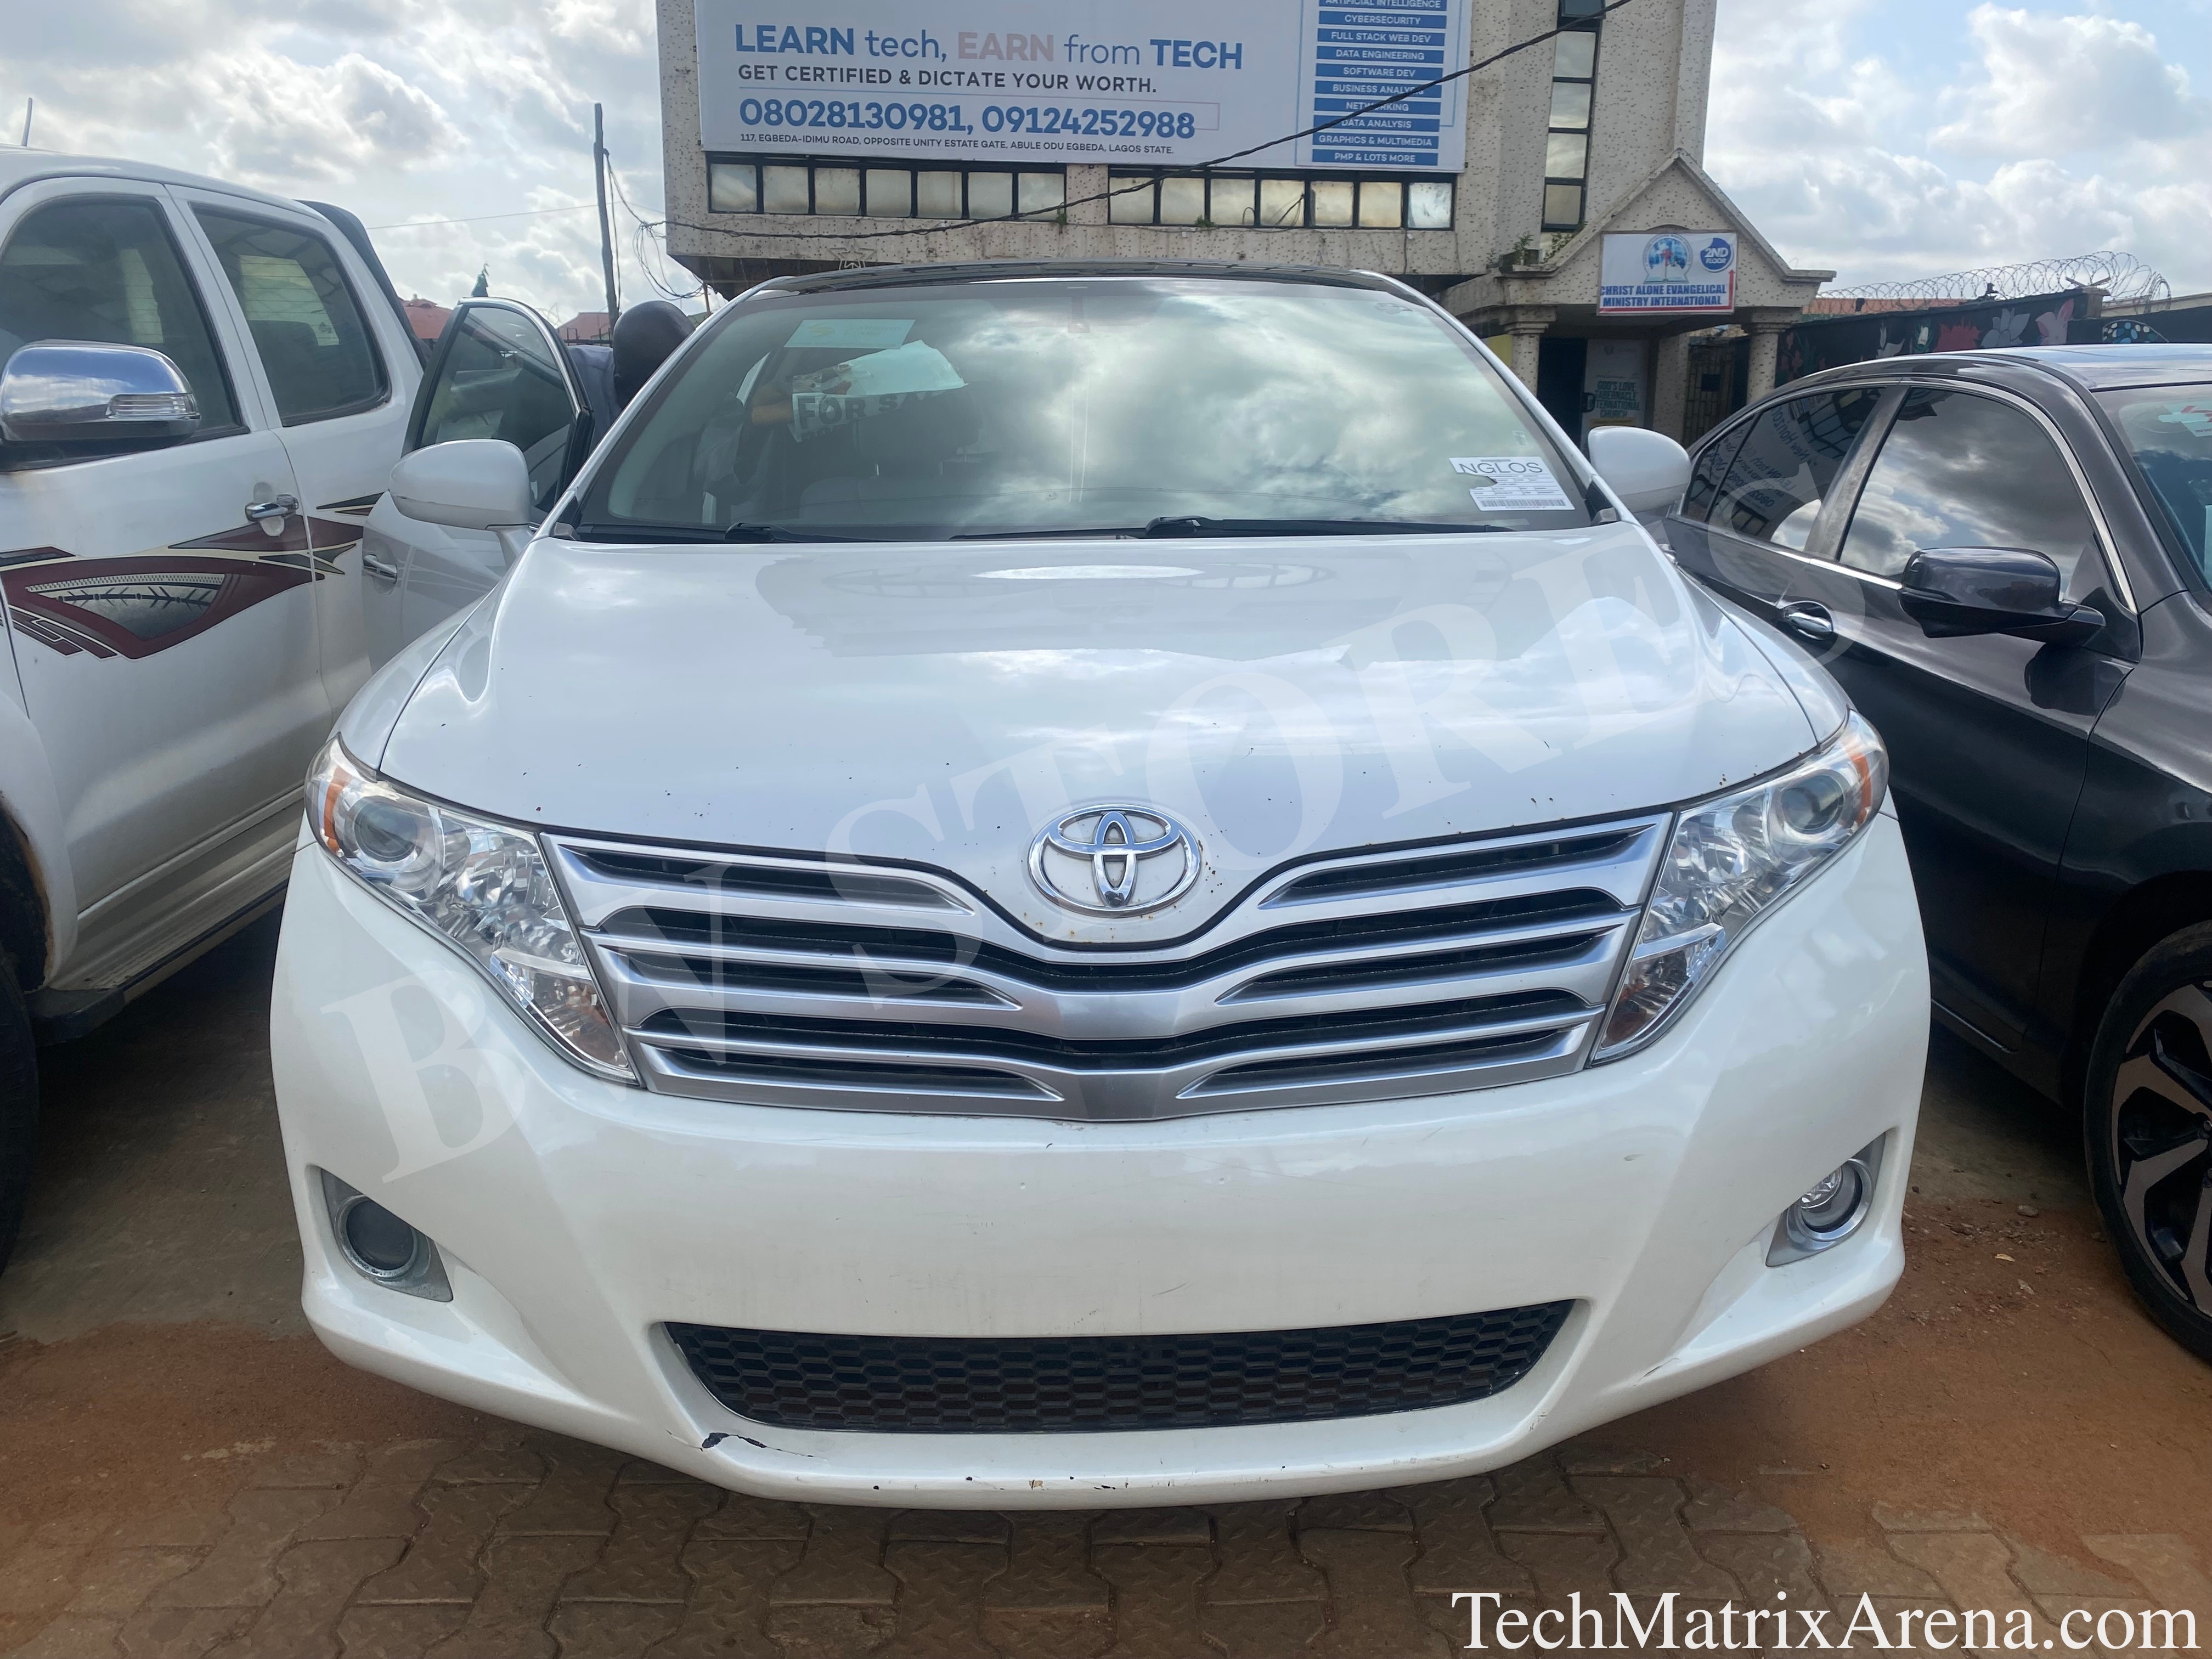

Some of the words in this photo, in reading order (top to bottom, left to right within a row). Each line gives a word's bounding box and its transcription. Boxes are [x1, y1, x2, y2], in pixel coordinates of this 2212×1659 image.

[1376, 0, 1441, 8] INTELLIGENCE
[1344, 14, 1421, 25] CYBERSECURITY
[1331, 31, 1353, 40] FULL
[1356, 33, 1386, 41] STACK
[1412, 35, 1431, 43] DEV
[735, 24, 854, 55] LEARN
[865, 29, 947, 62] tech,
[958, 31, 1054, 61] EARN
[1064, 34, 1140, 65] from
[1150, 38, 1243, 69] TECH
[1336, 49, 1359, 58] DATA
[1362, 50, 1425, 60] ENGINEERING
[1343, 67, 1395, 76] SOFTWARE
[1396, 69, 1416, 77] DEV
[738, 64, 778, 80] GET
[785, 65, 892, 84] CERTIFIED
[899, 69, 911, 84] &
[918, 70, 1006, 88] DICTATE
[1012, 72, 1069, 89] YOUR
[1076, 75, 1157, 93] WORTH.
[1332, 84, 1378, 93] BUSINESS
[1379, 86, 1424, 95] ANALYS
[1346, 101, 1409, 112] NETWRKING
[739, 98, 974, 135] 08028130981,
[982, 105, 1195, 139] 09124252988
[1341, 119, 1365, 127] DATA
[1367, 120, 1412, 128] ANALYSIS
[740, 133, 757, 142] 117,
[759, 134, 830, 144] EGBEDA-IDIMU
[832, 136, 861, 145] ROAD,
[864, 137, 911, 146] OPPOSITE
[913, 138, 942, 147] UNITY
[945, 139, 979, 148] ESTATE
[981, 140, 1008, 149] GATE,
[1010, 140, 1041, 150] ABULE
[1043, 142, 1064, 150] ODU
[1066, 143, 1107, 152] EGBEDA,
[1109, 144, 1142, 153] LAGOS
[1143, 145, 1174, 154] STATE.
[1318, 134, 1367, 144] GRAPHICS
[1368, 136, 1375, 144] &
[1377, 137, 1432, 146] MULTIMEDIA
[1334, 153, 1353, 161] PMP
[1364, 154, 1387, 162] LOTS
[1389, 154, 1416, 162] MORE
[1705, 247, 1729, 257] 2ND
[1600, 285, 1634, 296] CHRIST
[1635, 285, 1664, 295] ALONE
[1666, 284, 1727, 295] EVANGELICAL
[1602, 297, 1649, 307] MINISTRY
[1650, 296, 1722, 306] INTERNATIONAL
[1619, 382, 1637, 391] LOVE
[1595, 390, 1637, 400] TABERNACLE
[1595, 400, 1640, 410] TERNATIONAL
[797, 394, 866, 430] FOR
[1459, 462, 1543, 474] NGLOS
